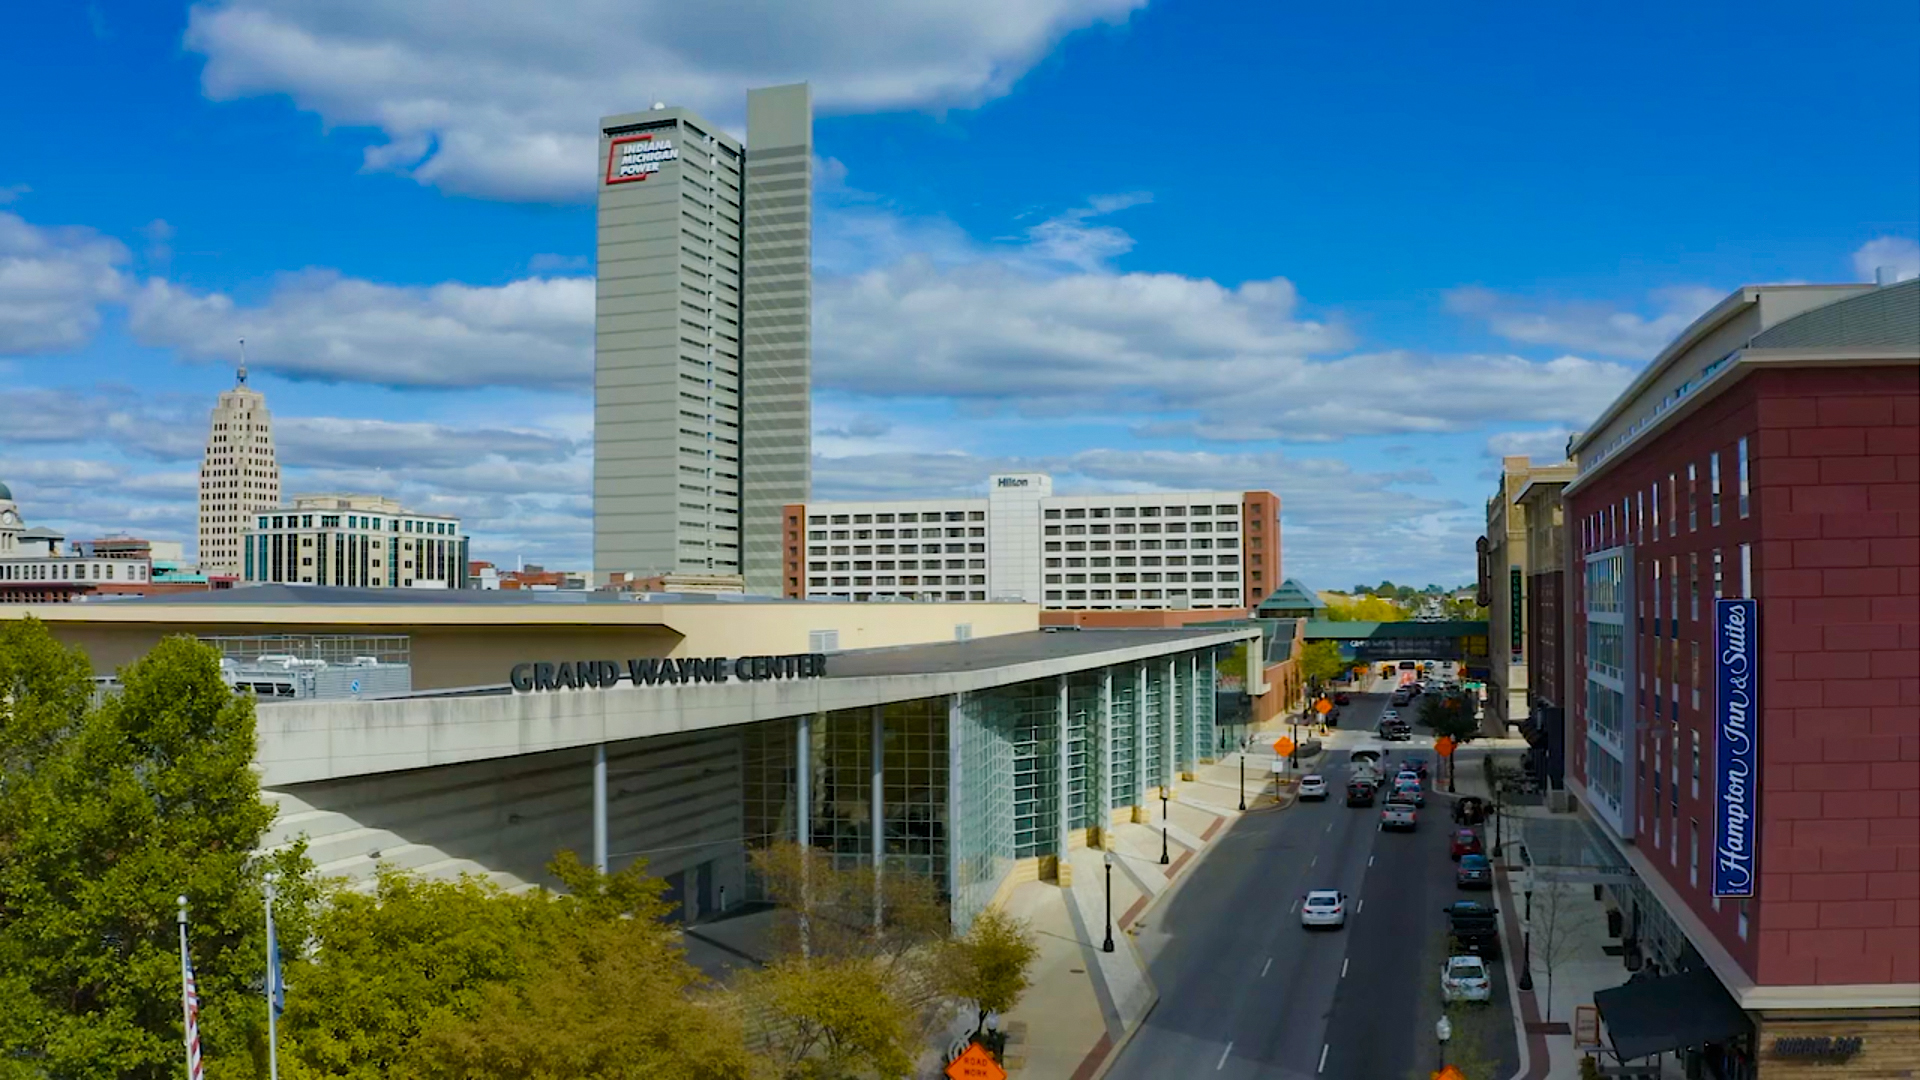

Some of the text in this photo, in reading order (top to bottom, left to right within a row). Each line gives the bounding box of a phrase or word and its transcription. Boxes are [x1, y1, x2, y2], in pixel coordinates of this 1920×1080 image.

[623, 140, 672, 154] INDIANA
[621, 148, 679, 165] MICHIGAN
[620, 161, 660, 175] POWER
[997, 477, 1028, 487] Hilton
[1722, 604, 1748, 675] Suites
[510, 653, 828, 693] GRAND WAYNE CENTER
[1729, 672, 1749, 689] &
[1724, 689, 1750, 756] Inn
[1718, 758, 1750, 887] Hampton
[964, 1057, 988, 1067] ROAD
[964, 1068, 988, 1078] WORK
